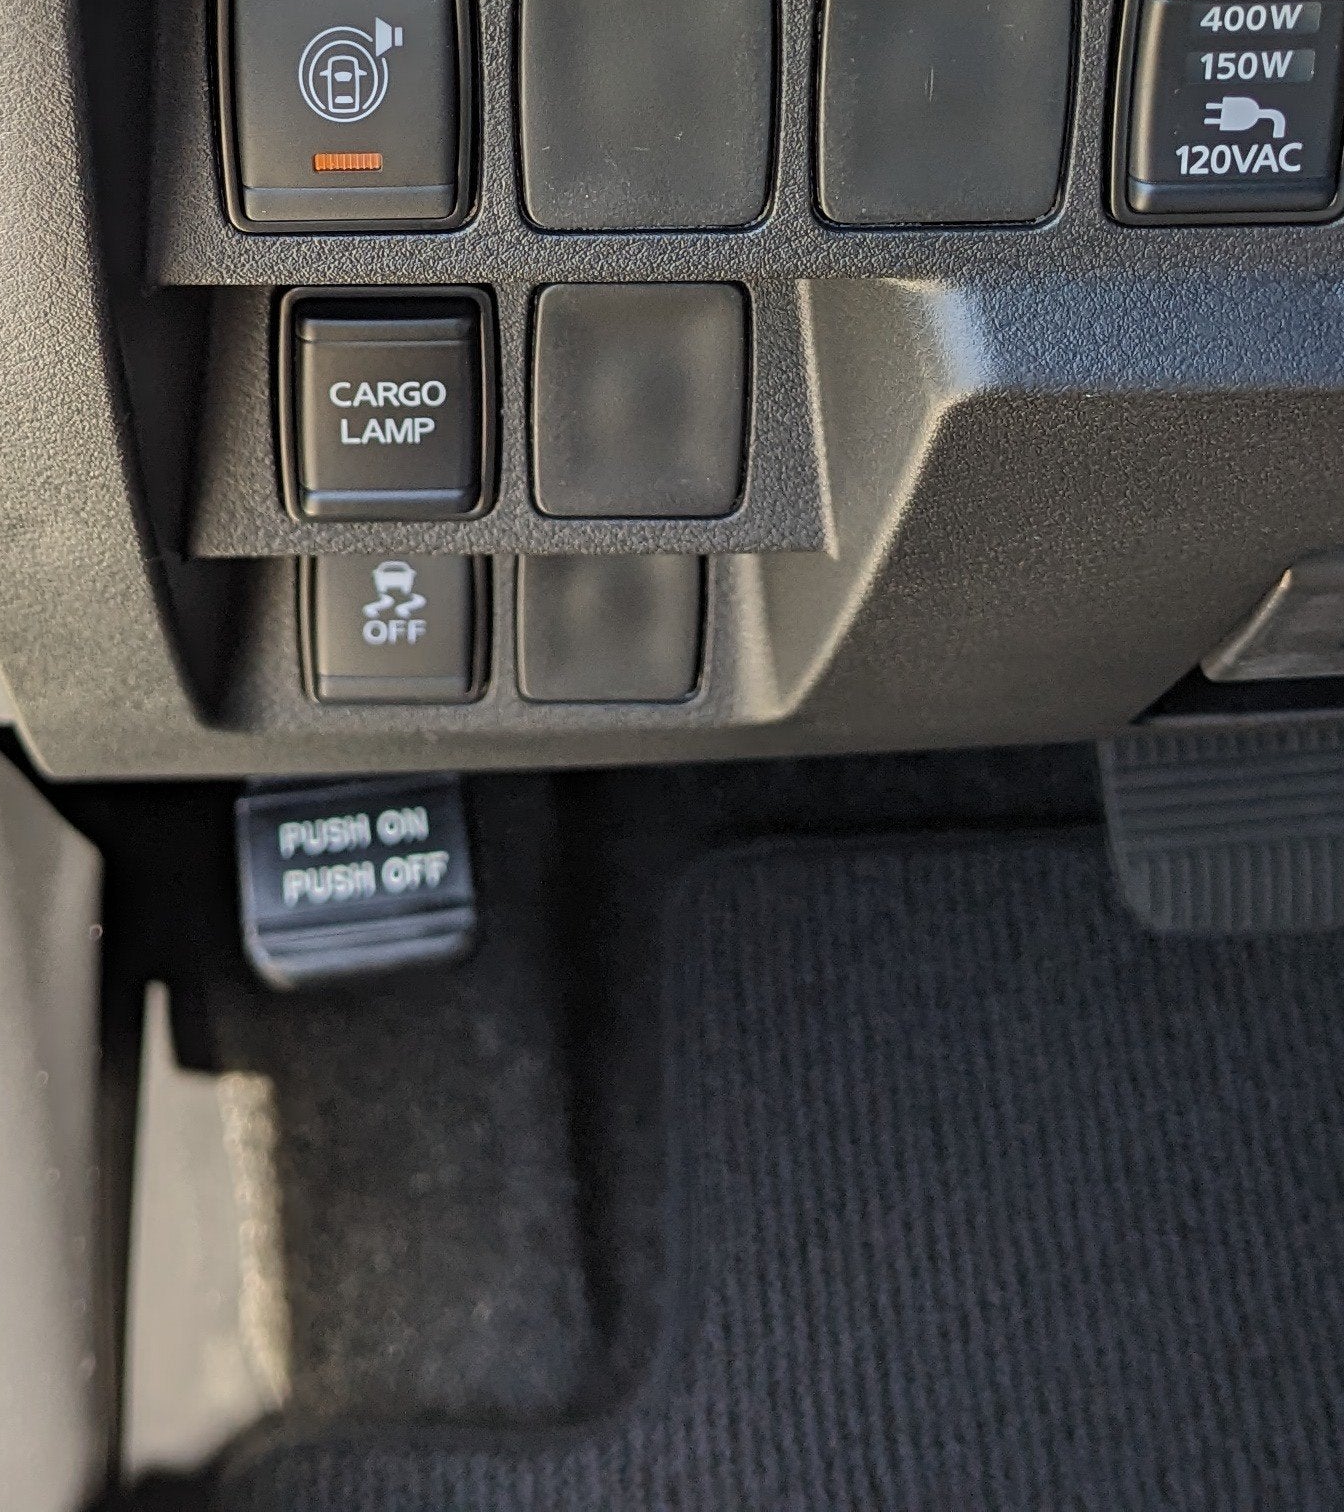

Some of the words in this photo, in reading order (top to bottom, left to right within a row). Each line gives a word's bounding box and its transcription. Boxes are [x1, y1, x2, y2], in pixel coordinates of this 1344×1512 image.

[1199, 3, 1304, 32] 400W
[1199, 50, 1294, 80] 150W
[1175, 142, 1304, 175] 120VAC
[329, 380, 448, 408] CARGO
[340, 417, 436, 445] LAMP
[362, 619, 428, 646] OFF
[278, 812, 372, 859] PUSH
[376, 806, 430, 846] ON
[282, 860, 376, 906] PUSH
[381, 850, 449, 894] OFF
